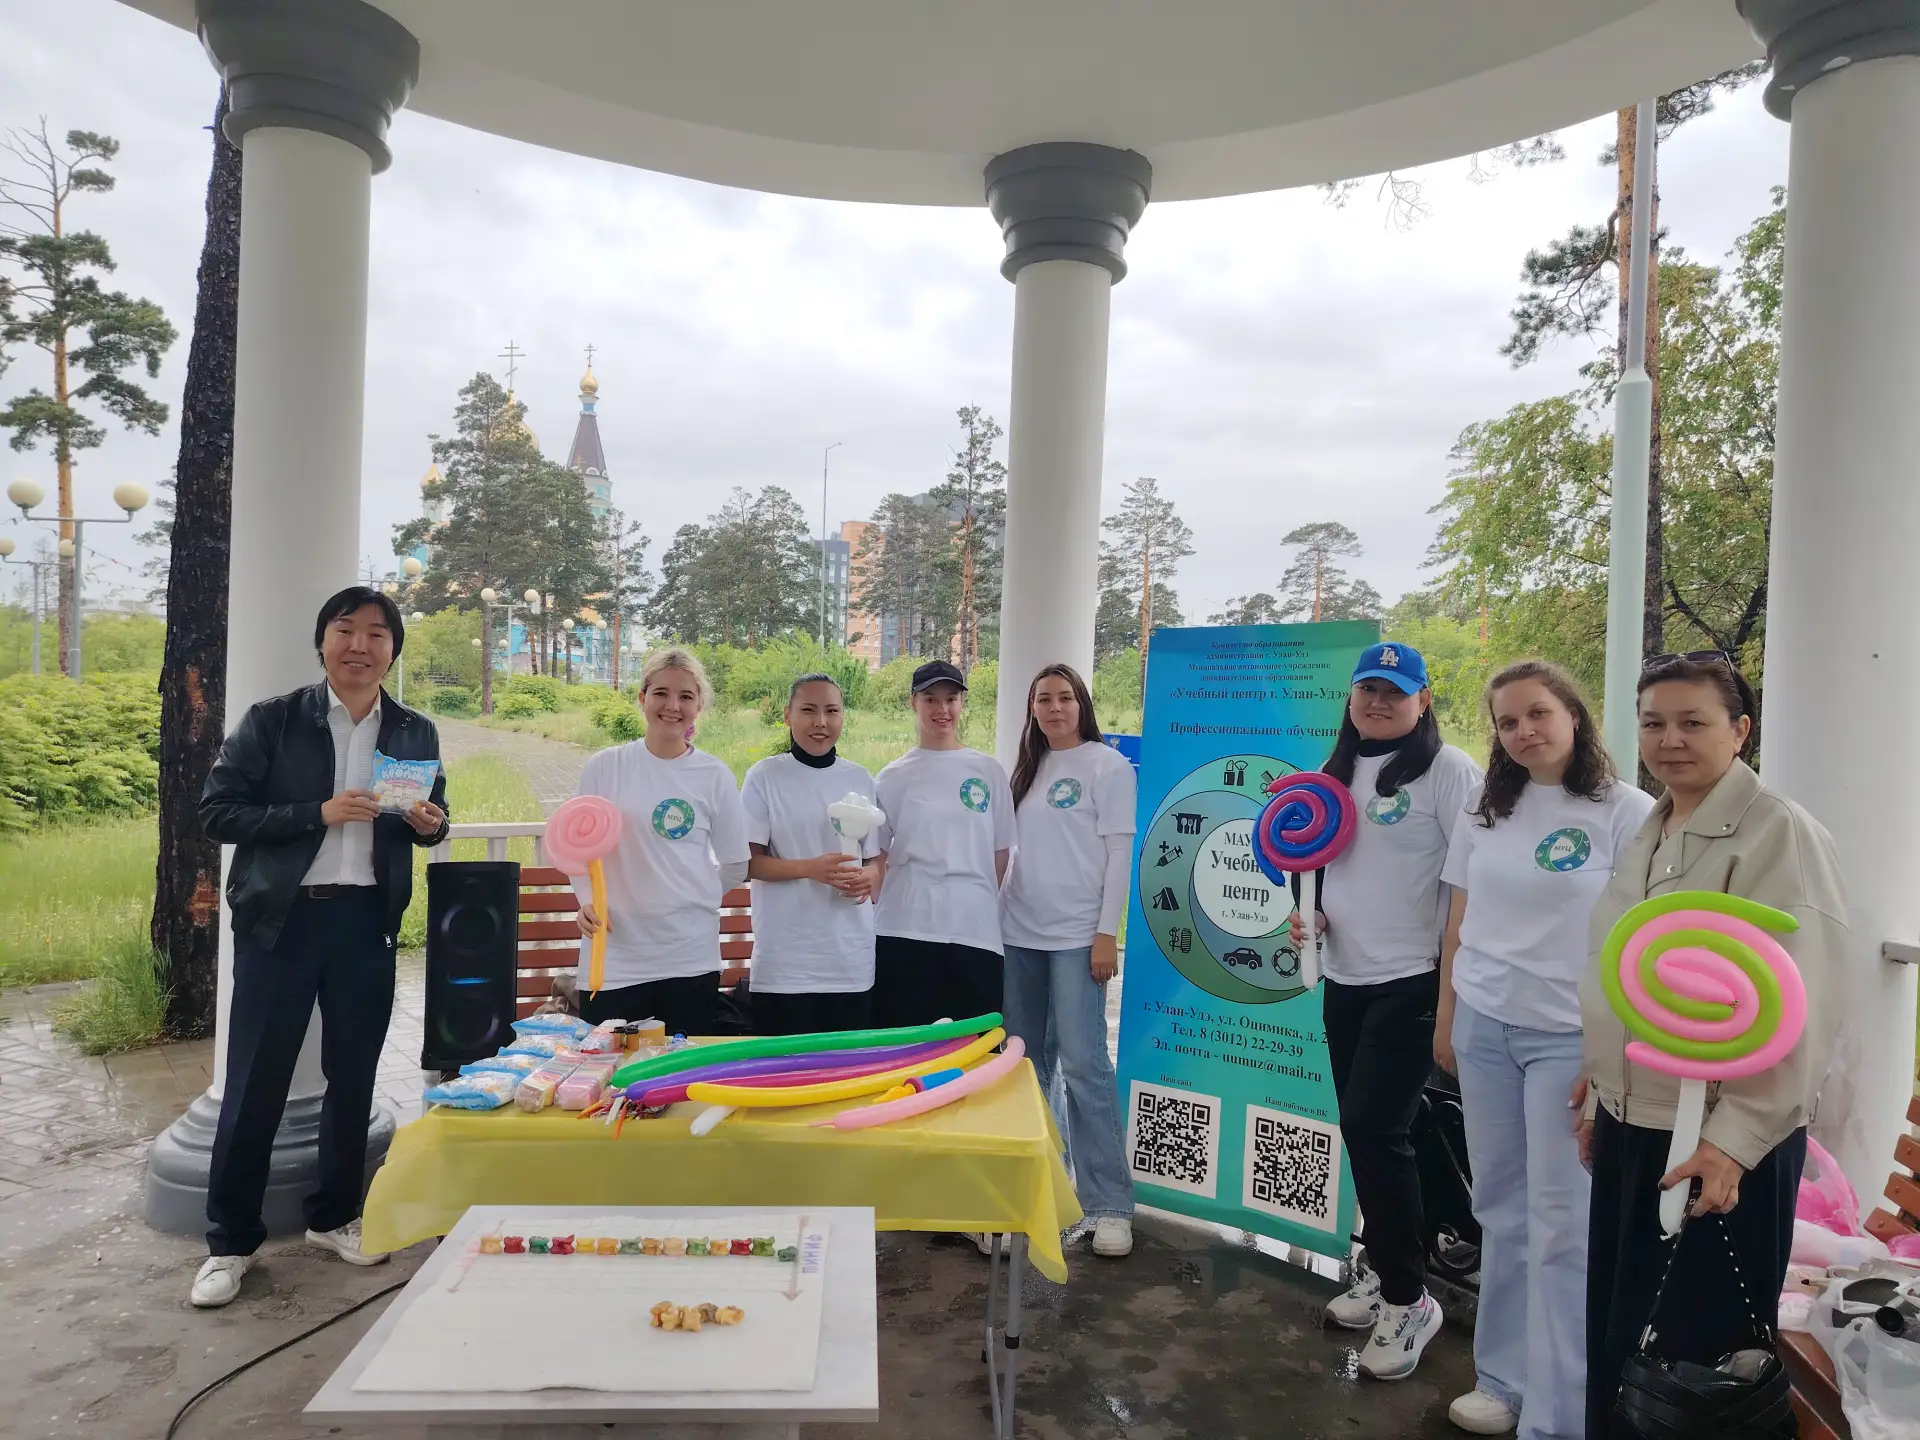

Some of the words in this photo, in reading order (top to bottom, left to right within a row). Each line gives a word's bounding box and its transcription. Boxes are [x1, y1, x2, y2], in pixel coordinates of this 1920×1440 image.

[1380, 647, 1399, 667] LA
[1170, 687, 1228, 700] «Учебный
[1231, 689, 1267, 701] центр
[1270, 690, 1277, 699] г.
[1282, 687, 1349, 701] Улан-Удэ»
[1170, 721, 1283, 737] Профессиональное
[1210, 849, 1263, 874] Учебн
[1222, 884, 1270, 907] центр
[1222, 910, 1228, 918] г.
[1231, 908, 1269, 923] Улан-Удэ
[1143, 1002, 1151, 1011] г.
[1155, 1001, 1214, 1024] Улан-Удэ,
[1218, 1014, 1236, 1030] ул.
[1239, 1016, 1303, 1041] Оцимика,
[1306, 1031, 1317, 1043] д.
[1171, 1022, 1196, 1038] Тел.
[1199, 1028, 1207, 1040] 8
[1210, 1028, 1248, 1049] (3012)
[1251, 1037, 1304, 1058] 22-29-39
[1151, 1037, 1171, 1052] Эл.
[1174, 1044, 1211, 1060] почта
[1222, 1054, 1323, 1083] uumuz@mail.ru
[1160, 1074, 1175, 1084] Наш
[1176, 1077, 1193, 1087] сайт
[1265, 1096, 1281, 1107] Наш
[1316, 1108, 1328, 1118] ВК
[803, 1234, 823, 1274] ФИНИШ
